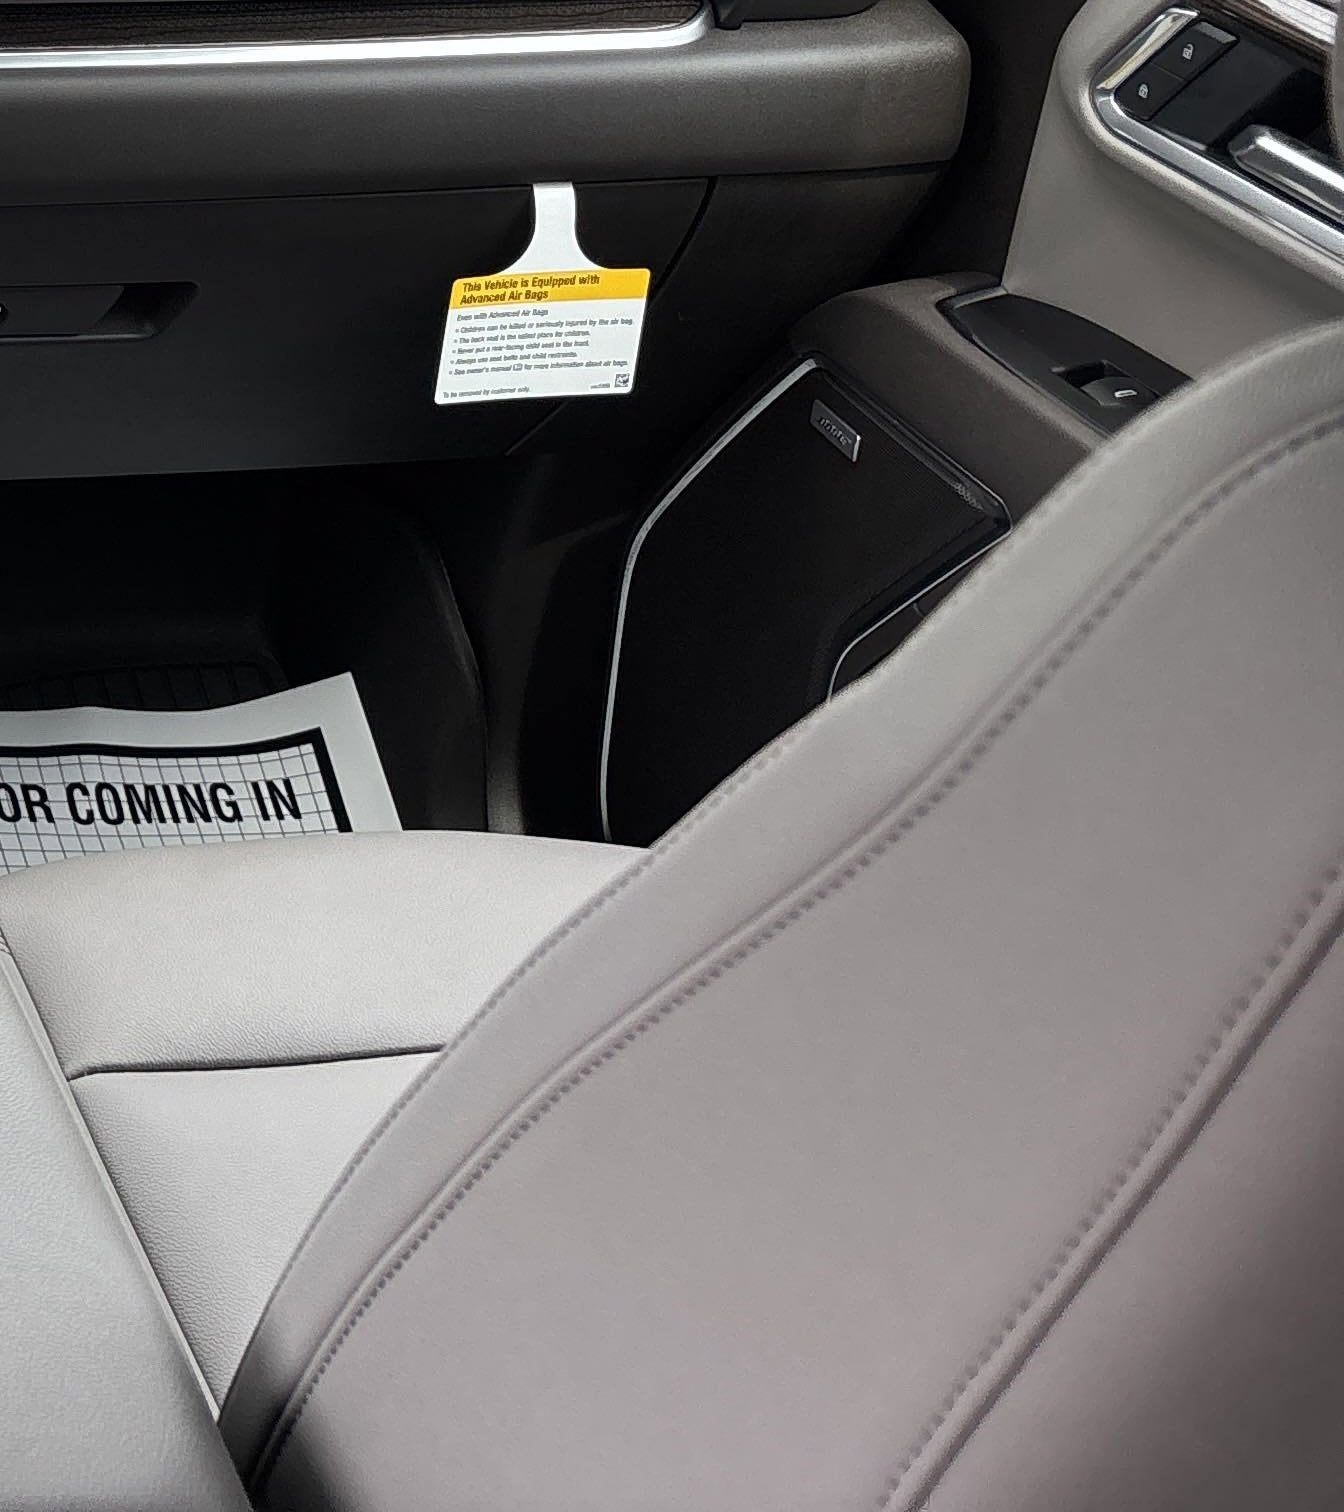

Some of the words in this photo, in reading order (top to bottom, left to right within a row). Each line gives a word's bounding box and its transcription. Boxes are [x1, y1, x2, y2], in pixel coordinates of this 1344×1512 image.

[461, 280, 482, 292] This
[483, 278, 519, 290] Vehicle
[519, 277, 530, 288] is
[530, 275, 577, 288] Equipped
[577, 274, 600, 285] with
[460, 291, 506, 305] Advanced
[507, 290, 522, 302] Air
[523, 288, 549, 301] Bags
[67, 783, 242, 826] COMING
[250, 778, 302, 821] IN
